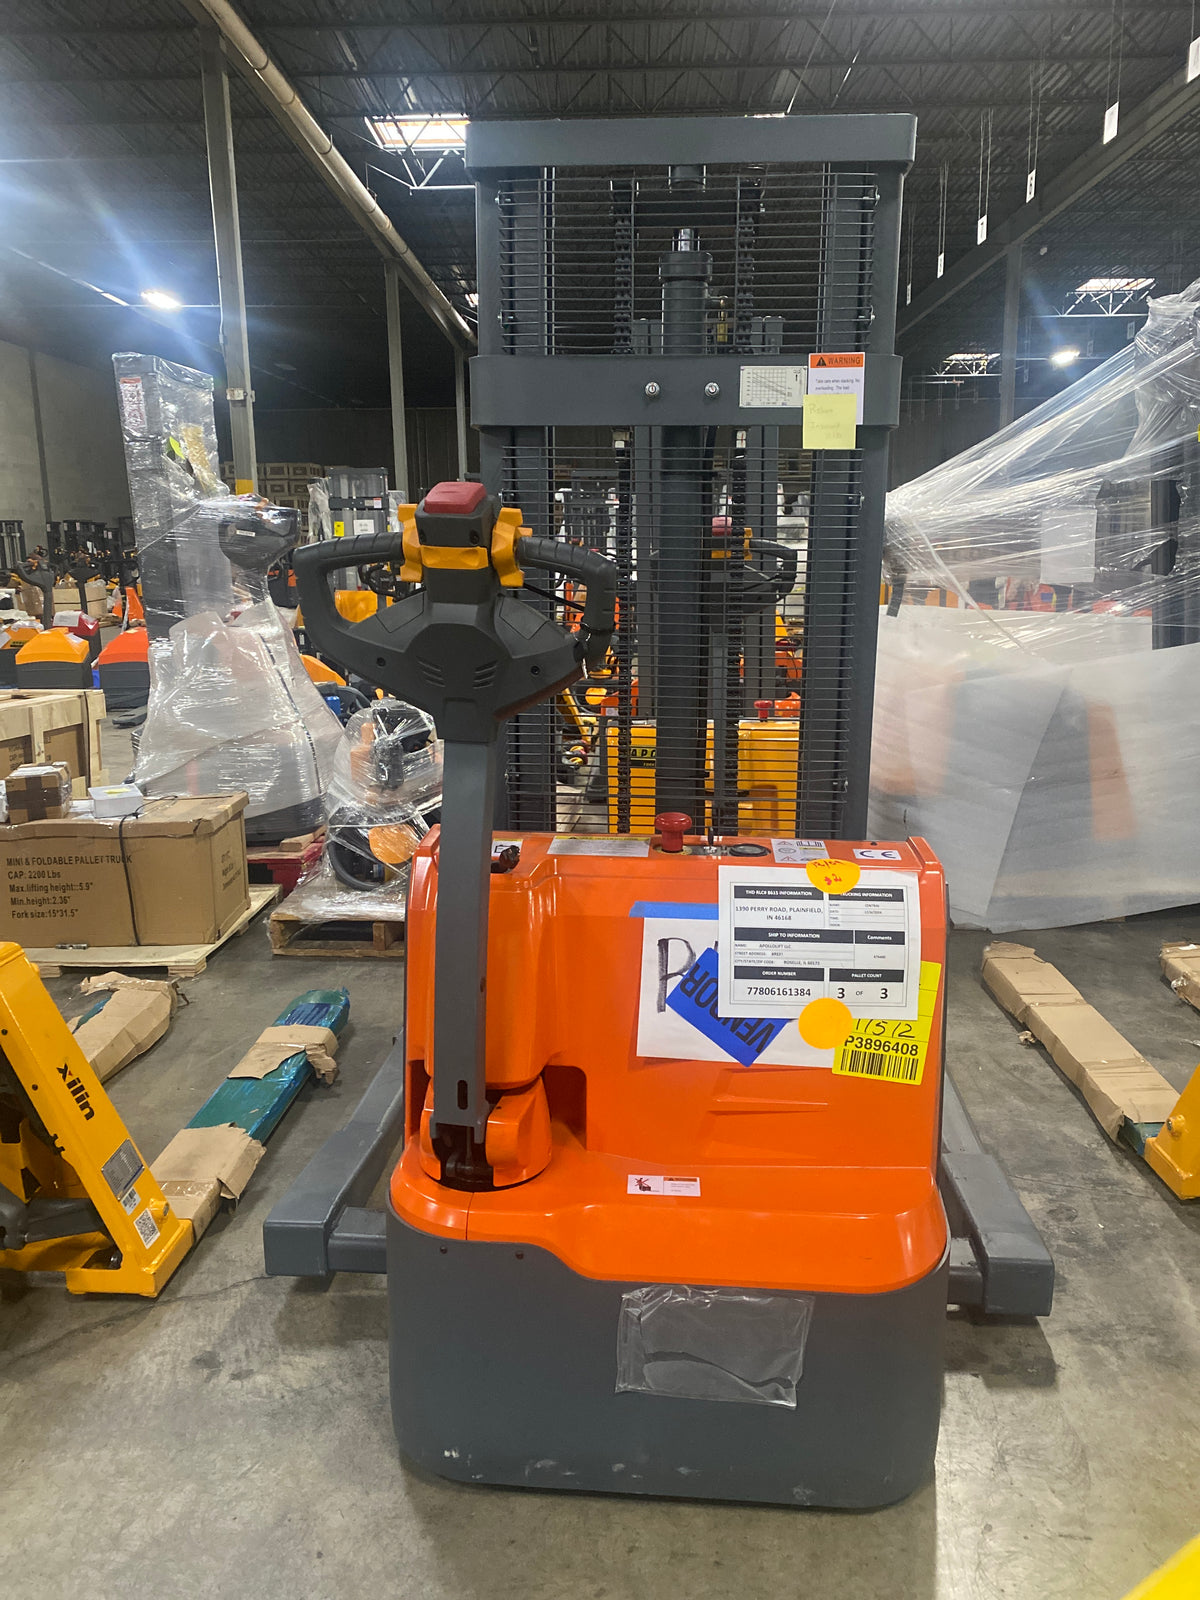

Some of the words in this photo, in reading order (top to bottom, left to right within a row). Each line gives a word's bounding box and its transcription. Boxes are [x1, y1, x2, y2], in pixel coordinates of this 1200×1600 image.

[828, 356, 861, 364] WARNING
[6, 857, 24, 866] MINI
[25, 858, 30, 866] &
[32, 856, 73, 866] FOLDABLE
[74, 855, 104, 865] PALLET
[105, 855, 133, 864] TRUK
[7, 871, 27, 880] CAP:
[28, 870, 46, 879] 2200
[47, 870, 61, 878] Lbs
[11, 909, 29, 919] Fork
[747, 986, 811, 997] 77806161384
[837, 987, 845, 999] 3
[880, 987, 888, 999] 3
[844, 1035, 919, 1056] P3896408
[56, 1063, 95, 1121] xilin
